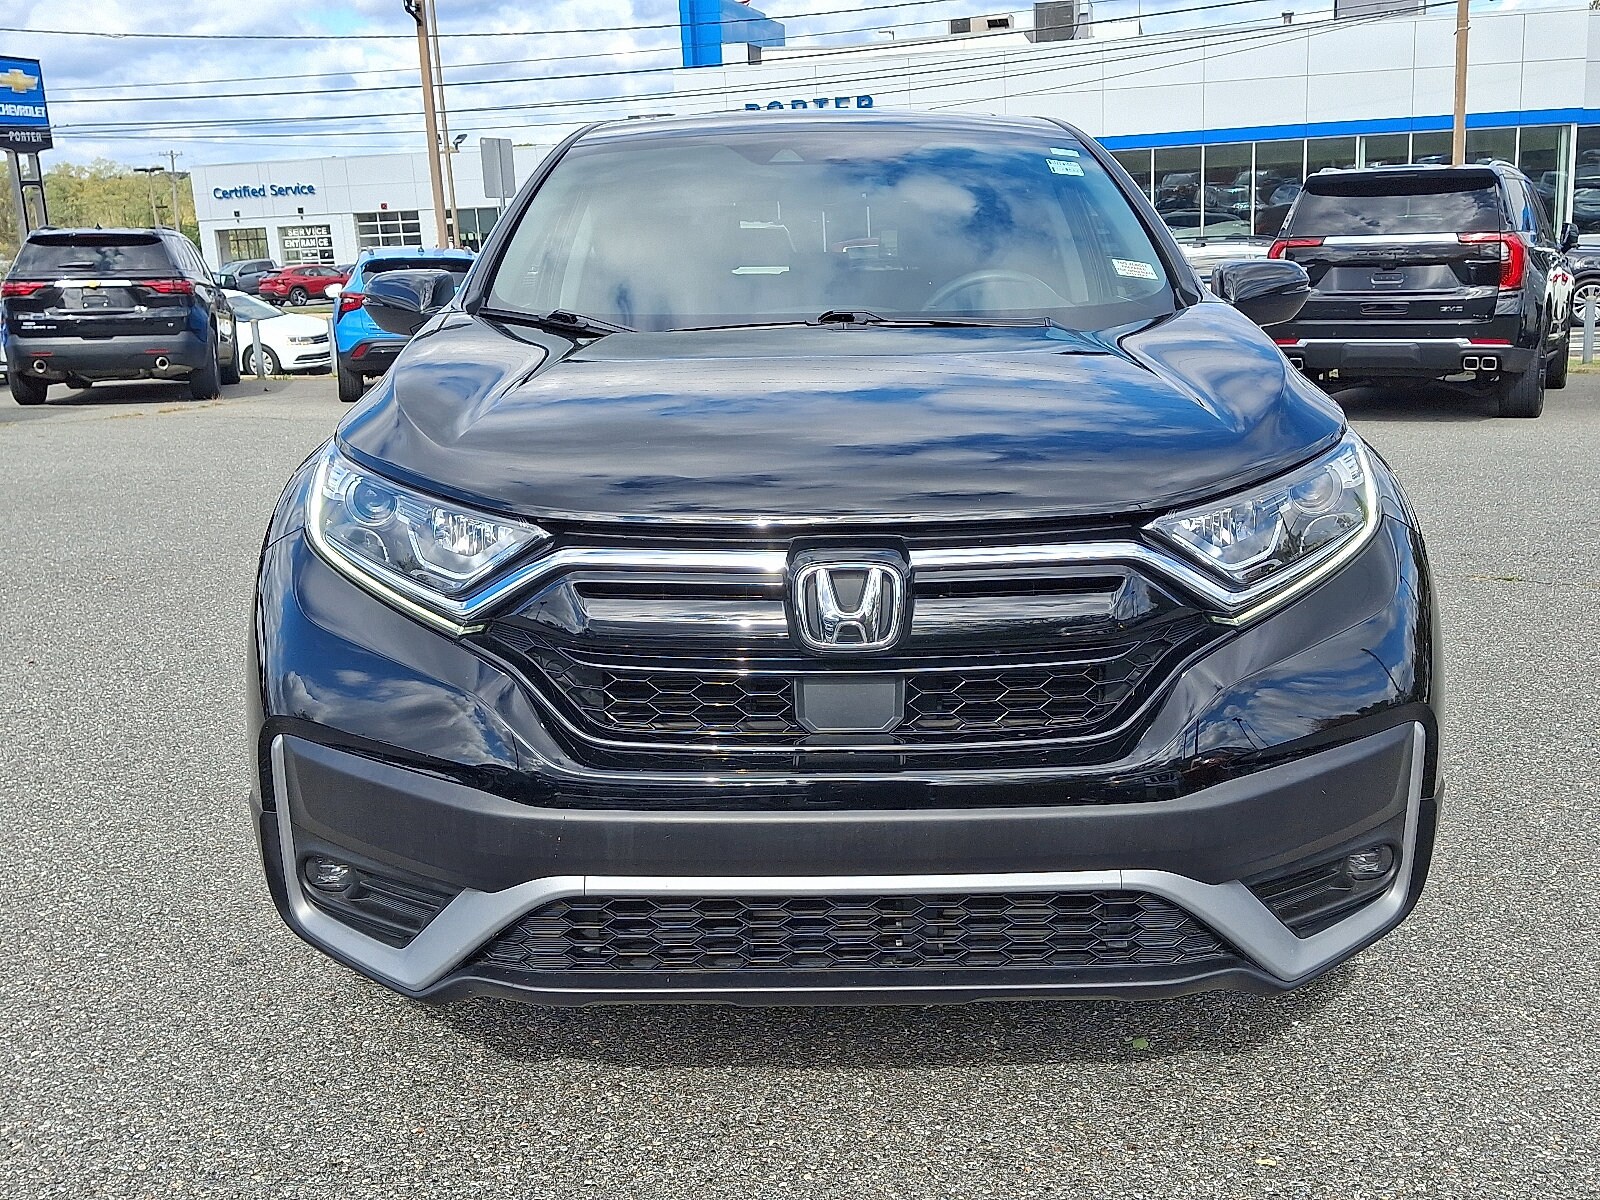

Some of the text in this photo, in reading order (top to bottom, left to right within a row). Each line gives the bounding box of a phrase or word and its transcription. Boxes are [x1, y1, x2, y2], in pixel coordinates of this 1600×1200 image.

[9, 131, 42, 142] PORTER
[213, 183, 315, 199] Certified Service
[288, 227, 328, 236] SERVICE
[285, 238, 329, 248] ENTRANCE
